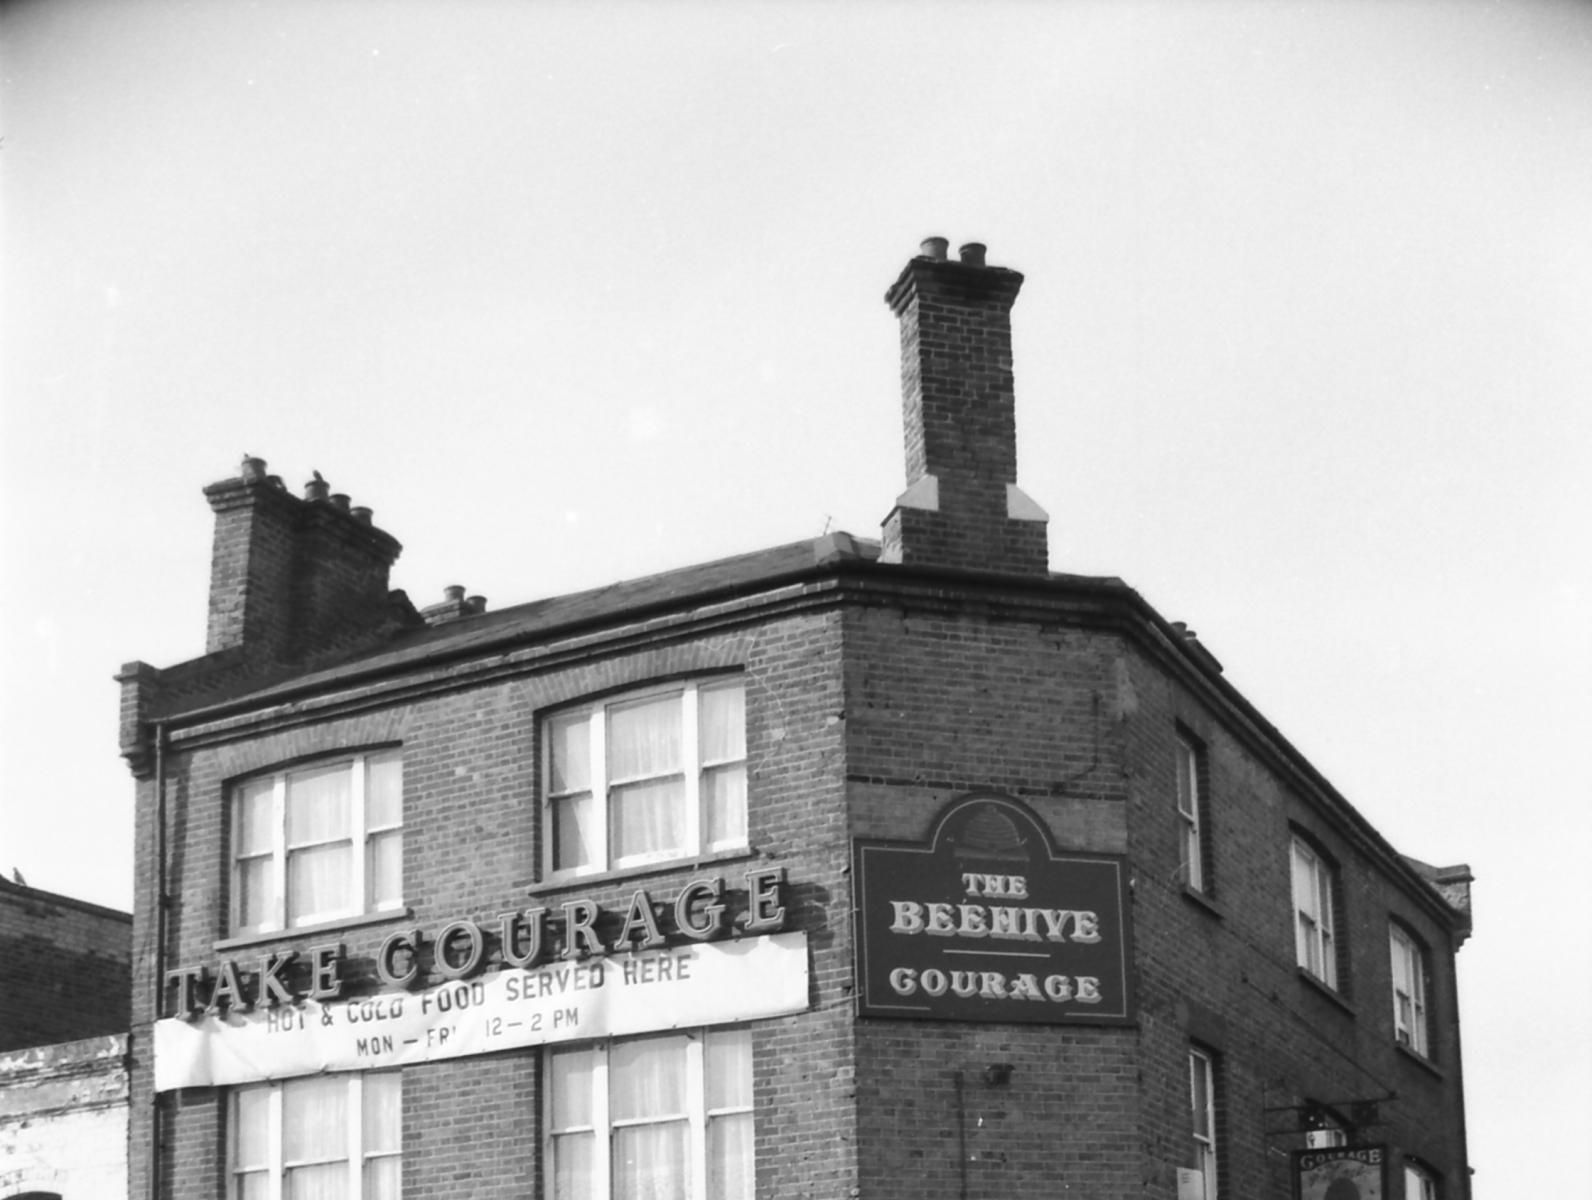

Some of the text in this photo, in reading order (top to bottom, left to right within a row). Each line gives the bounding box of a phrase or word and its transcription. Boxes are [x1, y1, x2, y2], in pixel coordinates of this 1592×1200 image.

[962, 873, 1029, 899] THE
[166, 866, 788, 1020] TAKE COURAGE
[889, 901, 1102, 944] BEEHIVE
[267, 954, 691, 1033] HOT & COLD FOOD SERVED HERE
[889, 967, 1102, 1003] COURAGE
[357, 1035, 393, 1056] MON
[553, 1007, 578, 1028] PM
[1300, 1149, 1382, 1169] COURAGE
